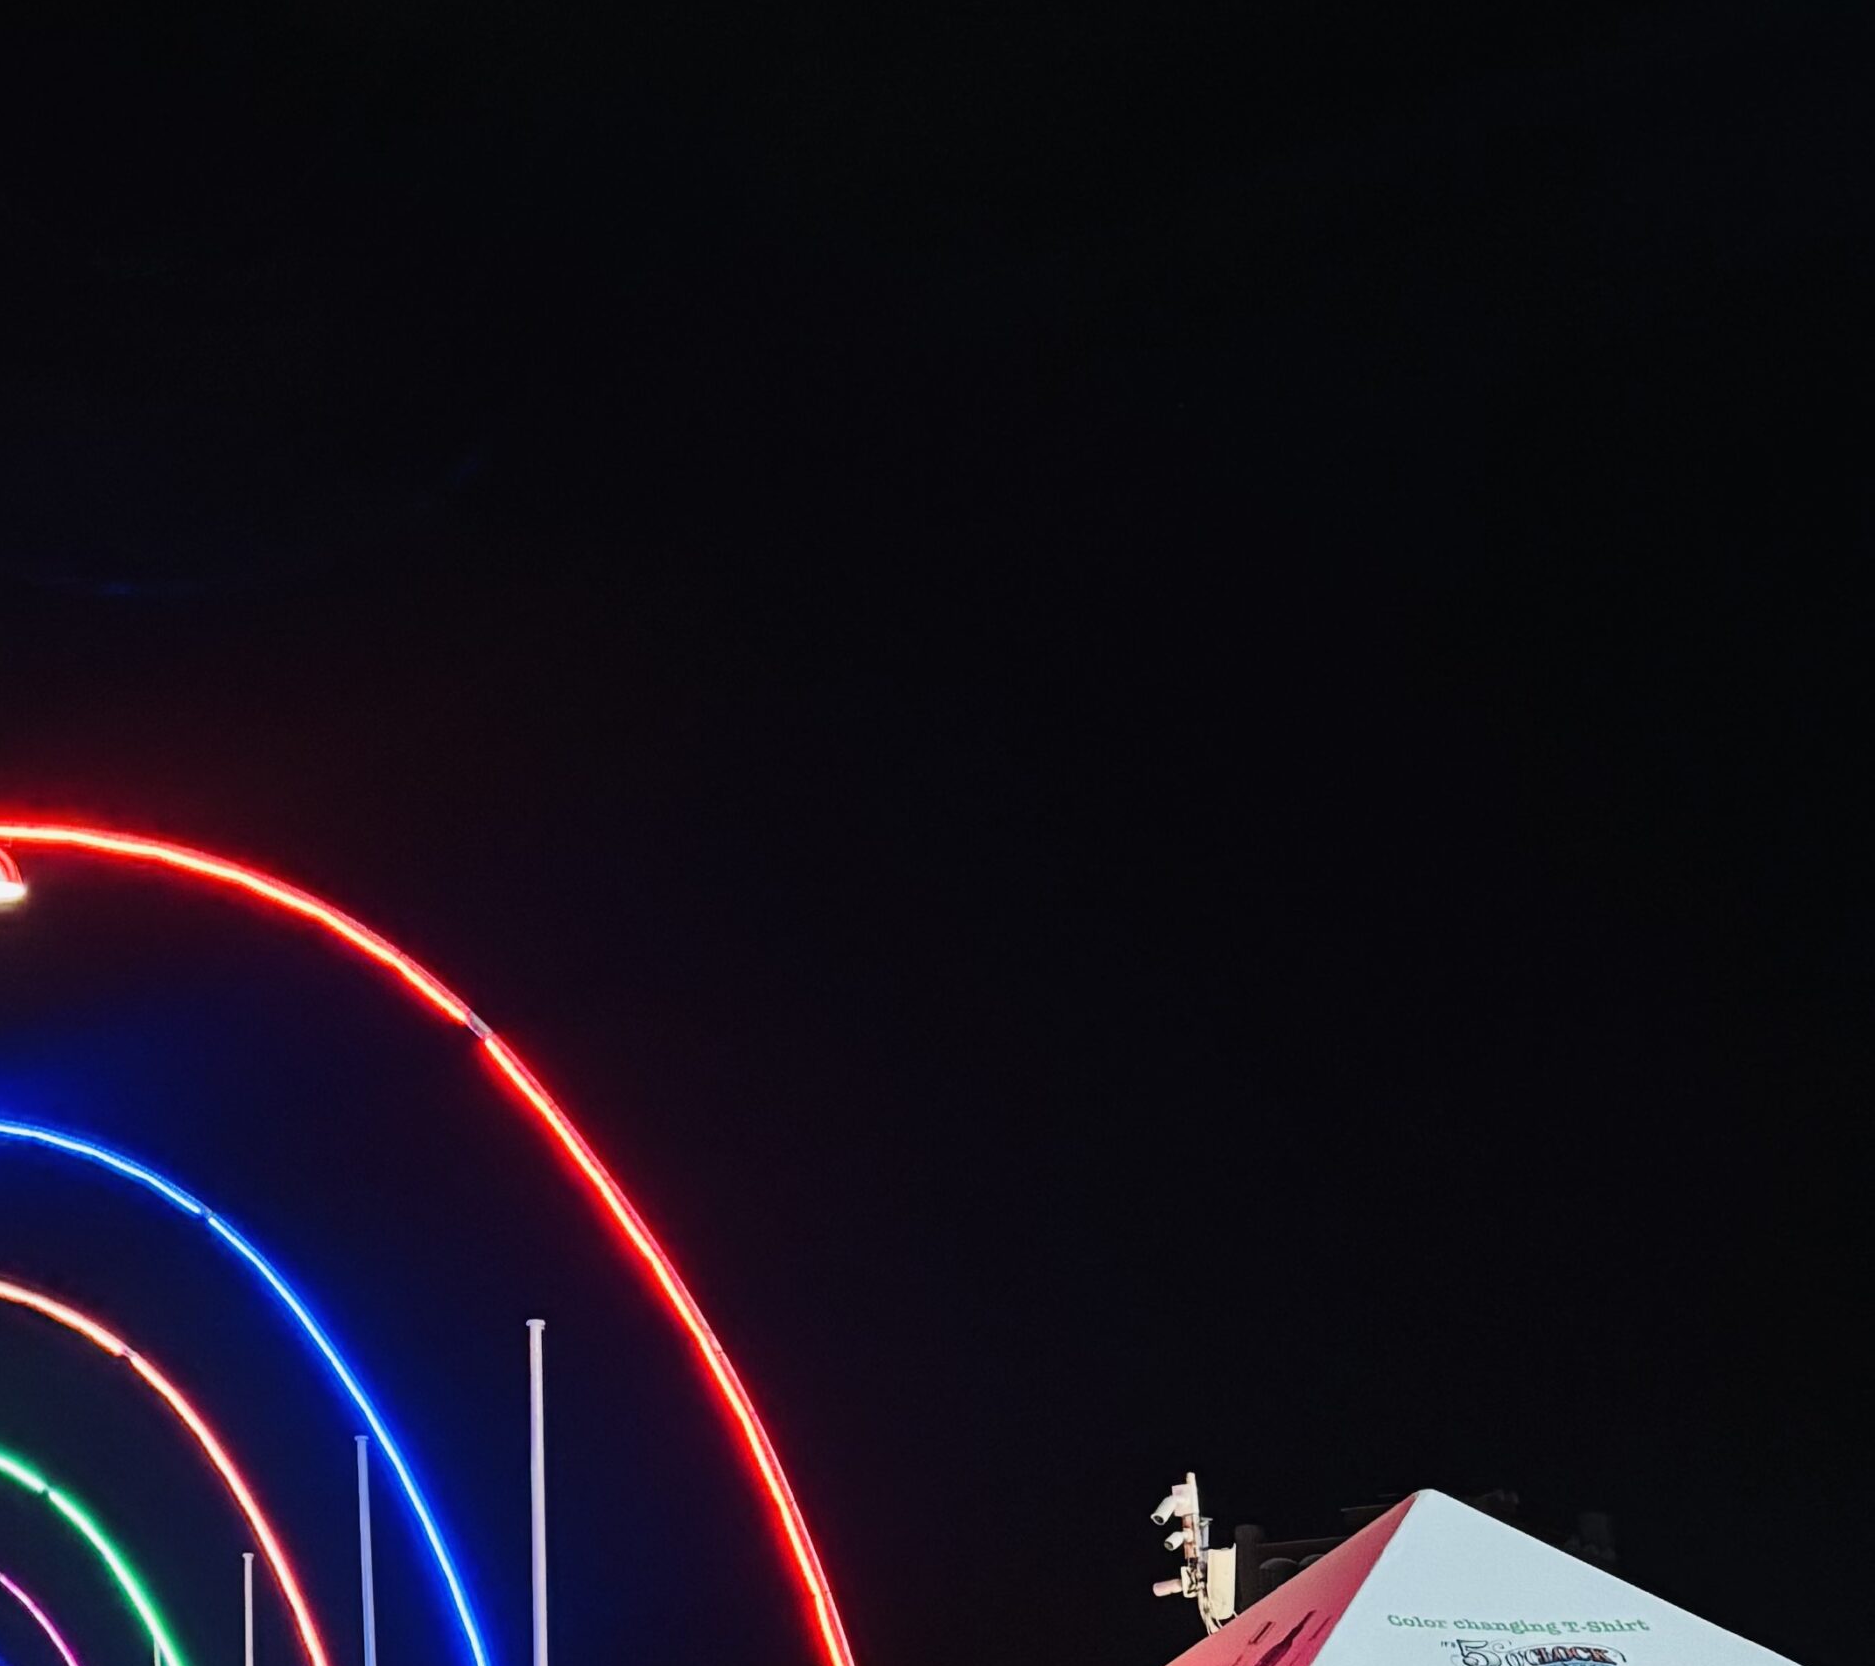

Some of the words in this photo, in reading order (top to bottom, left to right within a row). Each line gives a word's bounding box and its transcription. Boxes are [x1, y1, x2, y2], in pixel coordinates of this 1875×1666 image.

[1387, 1614, 1448, 1630] Color
[1453, 1619, 1560, 1634] changing
[1562, 1619, 1650, 1633] T-Shirt
